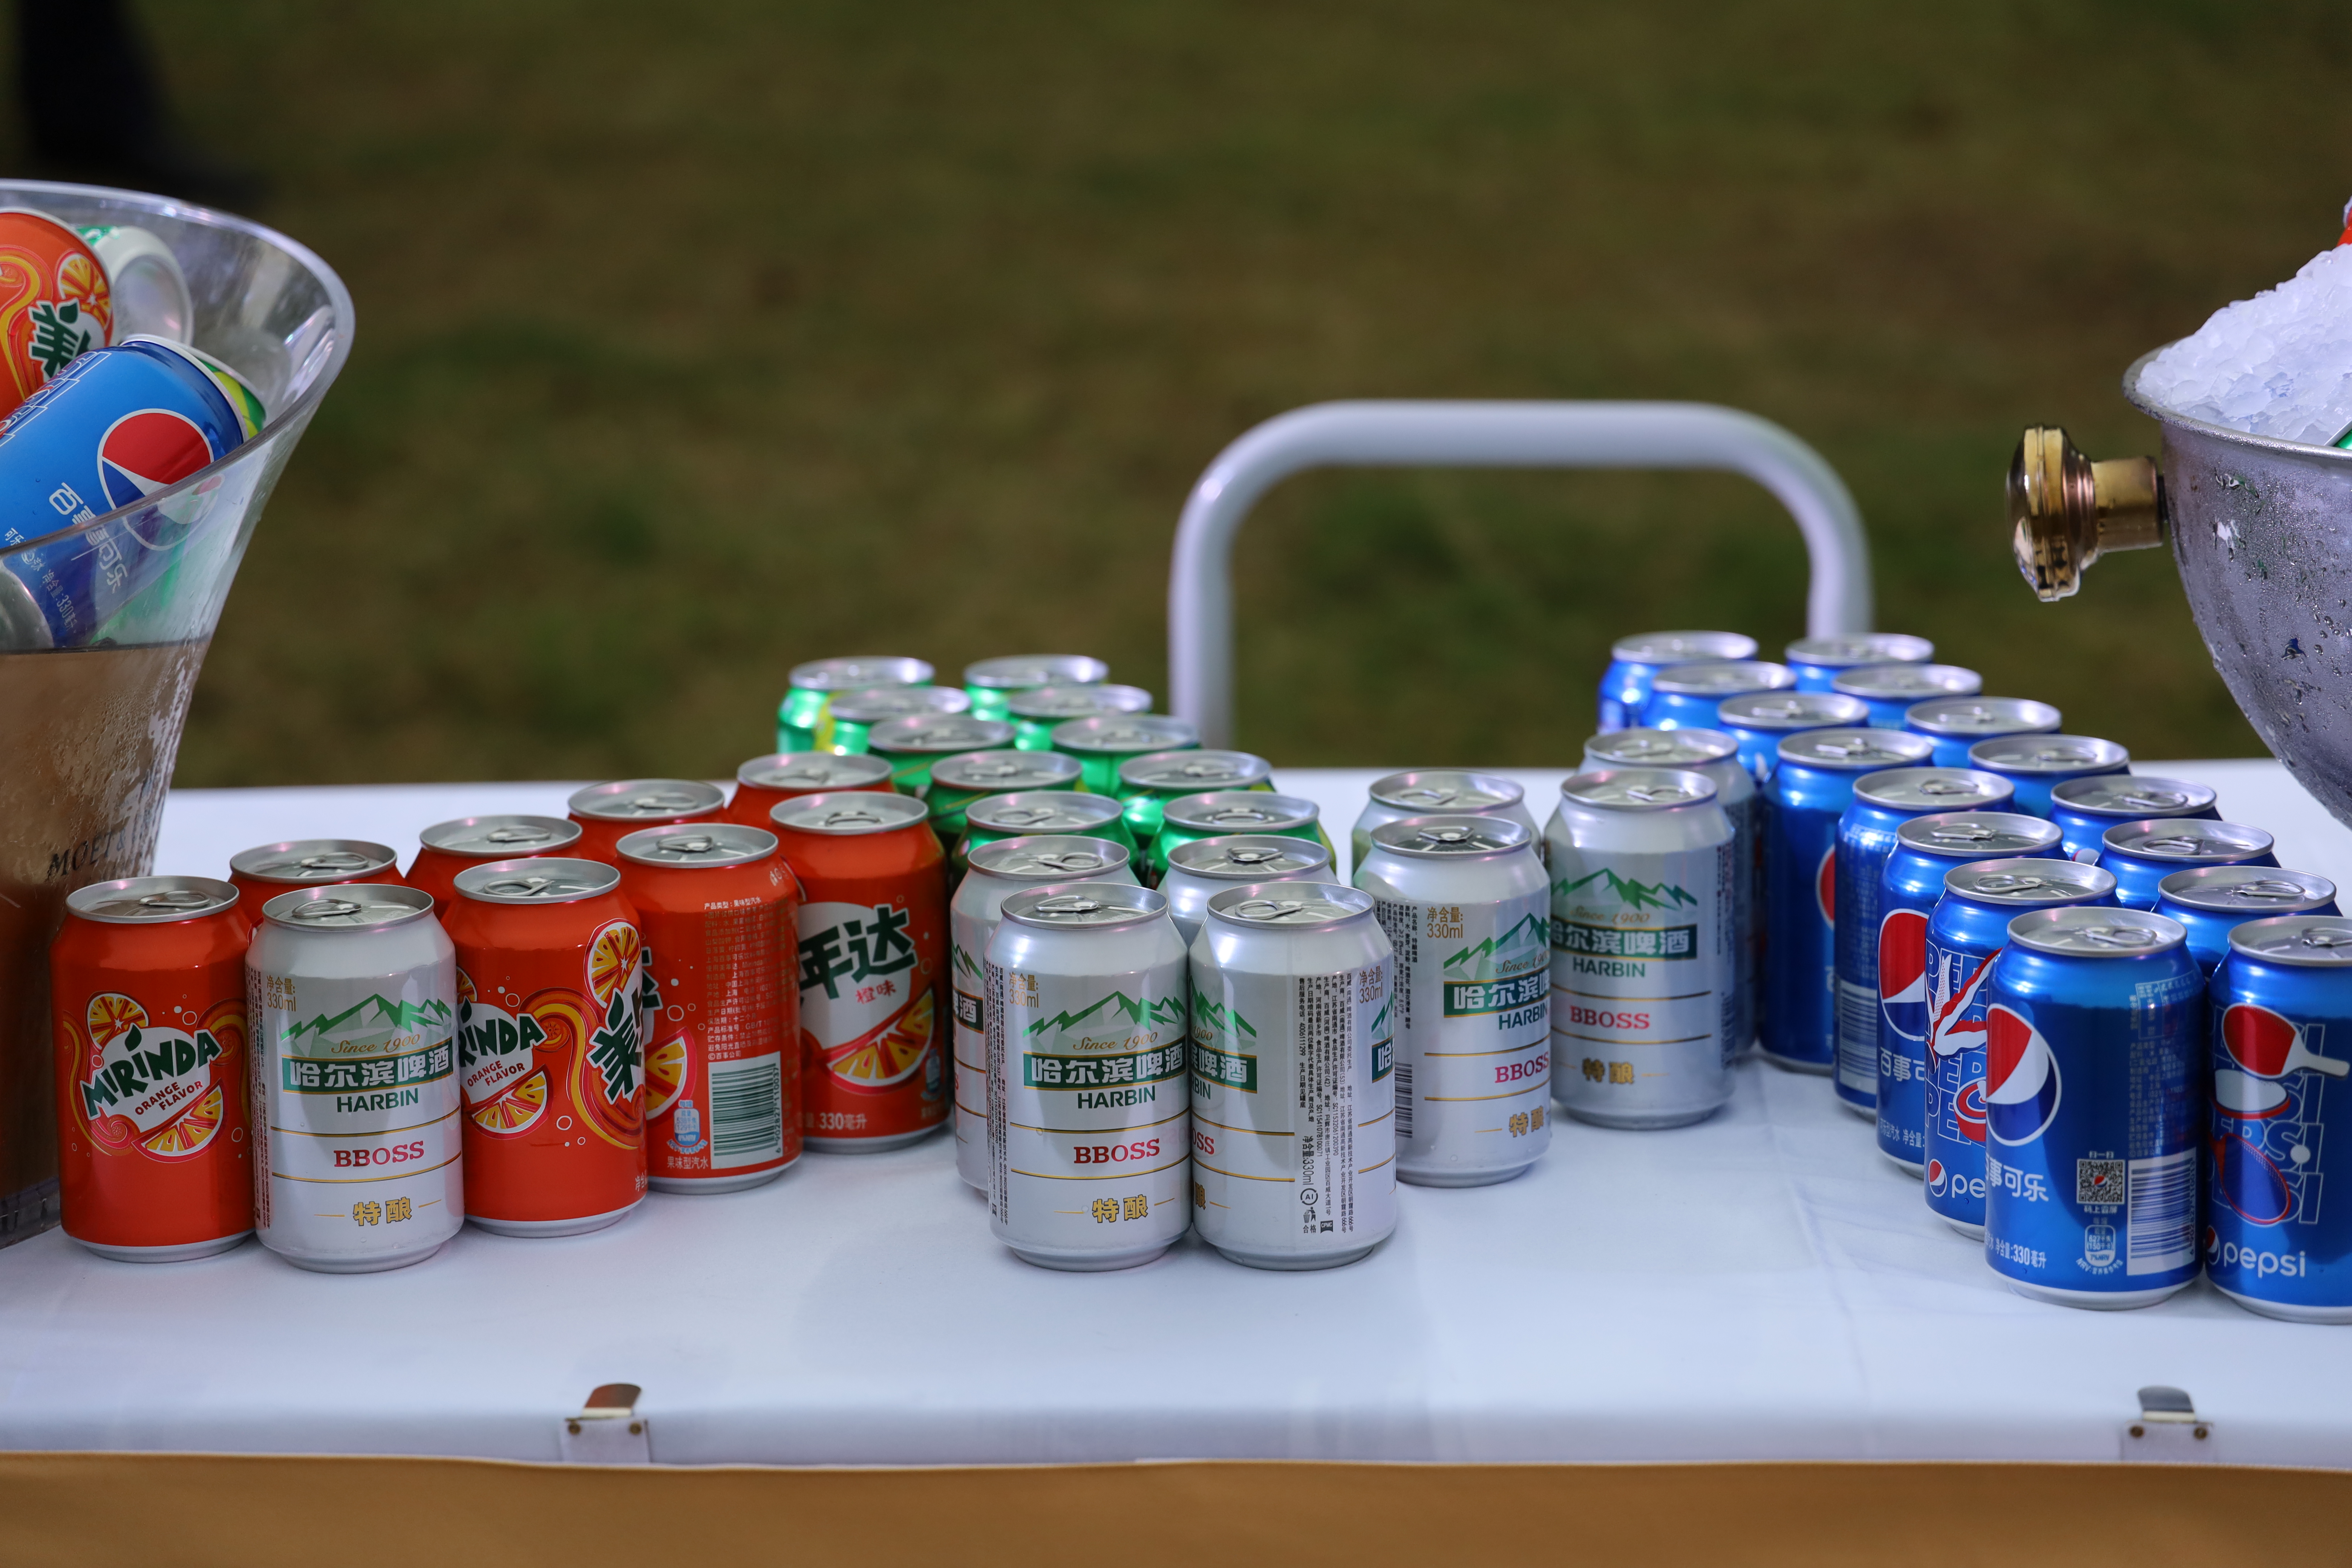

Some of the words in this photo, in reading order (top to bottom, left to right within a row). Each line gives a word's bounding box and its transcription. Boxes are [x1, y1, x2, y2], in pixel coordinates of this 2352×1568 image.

[1427, 906, 1463, 923] 净含量:
[1612, 913, 1651, 924] 1900
[1427, 923, 1463, 939] 330ml
[799, 906, 917, 1000] 年达
[1495, 960, 1529, 974] Since
[1573, 957, 1646, 977] HARBIN
[266, 975, 295, 995] 净含量:
[1009, 972, 1039, 992] 净含量:
[1359, 982, 1383, 1003] 330ml
[267, 992, 296, 1012] 330ml
[1010, 989, 1039, 1008] 330ml
[1499, 1002, 1547, 1030] HARBIN
[1570, 1006, 1650, 1029] BBOSS
[331, 1040, 377, 1054] Since
[383, 1034, 420, 1053] 1900
[458, 997, 545, 1067] RINDA
[1073, 1037, 1117, 1050] Since
[1123, 1032, 1158, 1049] 1900
[82, 1024, 220, 1117] MIRINDA
[290, 1048, 449, 1088] 哈尔滨啤酒
[467, 1060, 502, 1087] ORANGE
[485, 1063, 525, 1086] FLAVOR
[1032, 1043, 1183, 1084] 哈尔滨啤酒
[1191, 1042, 1247, 1083] 滨啤酒
[1495, 1052, 1550, 1083] BBOSS
[1880, 1047, 1925, 1081] 百事可
[135, 1082, 180, 1115] ORANGE
[159, 1081, 203, 1110] FLAVOR
[337, 1088, 418, 1112] HARBIN
[1078, 1086, 1156, 1109] HARBIN
[1191, 1075, 1211, 1100] RBIN
[1509, 1106, 1544, 1138] 特酿
[334, 1140, 424, 1167] BBOSS
[1074, 1138, 1160, 1163] BBOSS
[1192, 1129, 1214, 1155] OSS
[667, 1156, 708, 1169] 果味型汽水
[352, 1197, 412, 1227] 特酿
[1092, 1194, 1148, 1223] 特酿
[1303, 1224, 1316, 1234] 合格
[2224, 1242, 2306, 1278] pepsi
